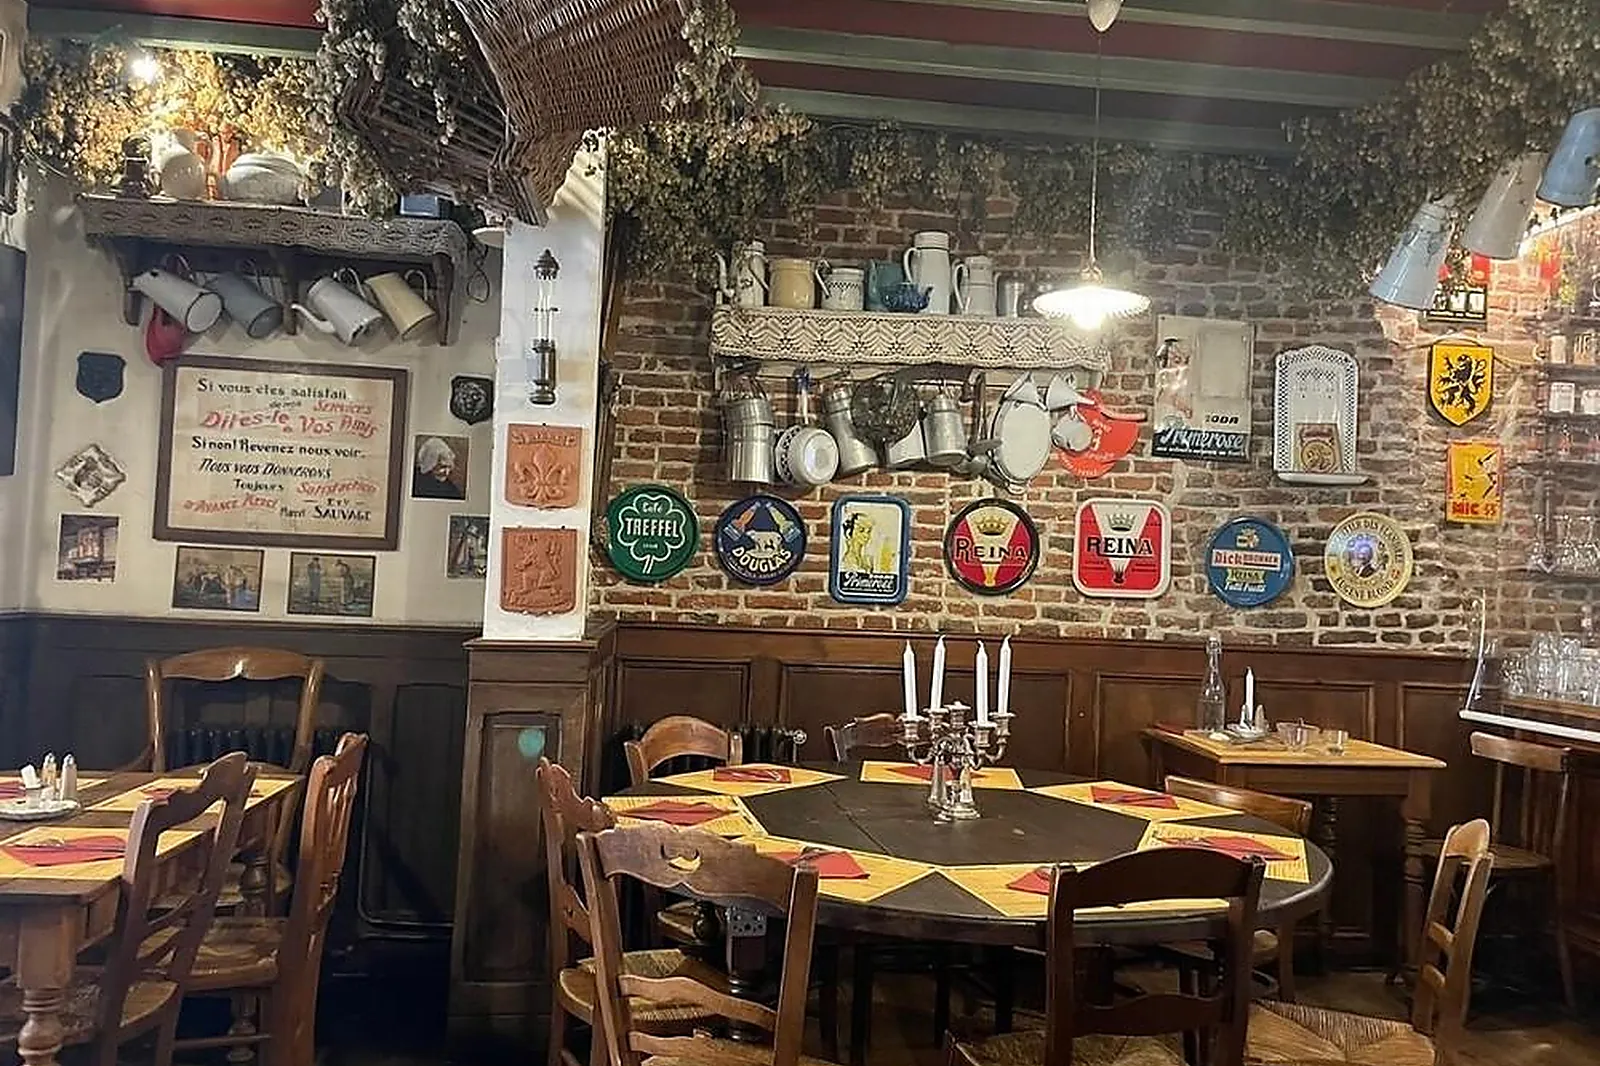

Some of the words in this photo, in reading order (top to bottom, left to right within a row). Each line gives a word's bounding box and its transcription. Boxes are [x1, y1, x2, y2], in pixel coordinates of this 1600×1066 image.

[197, 378, 213, 392] Si
[218, 384, 252, 394] vous
[239, 438, 295, 454] Revenez
[299, 446, 332, 456] nous
[233, 478, 284, 491] Toujours
[624, 517, 679, 538] TREFFEL
[954, 536, 1029, 564] REINA
[1086, 536, 1153, 556] REINA
[731, 545, 792, 572] DOUGLAS
